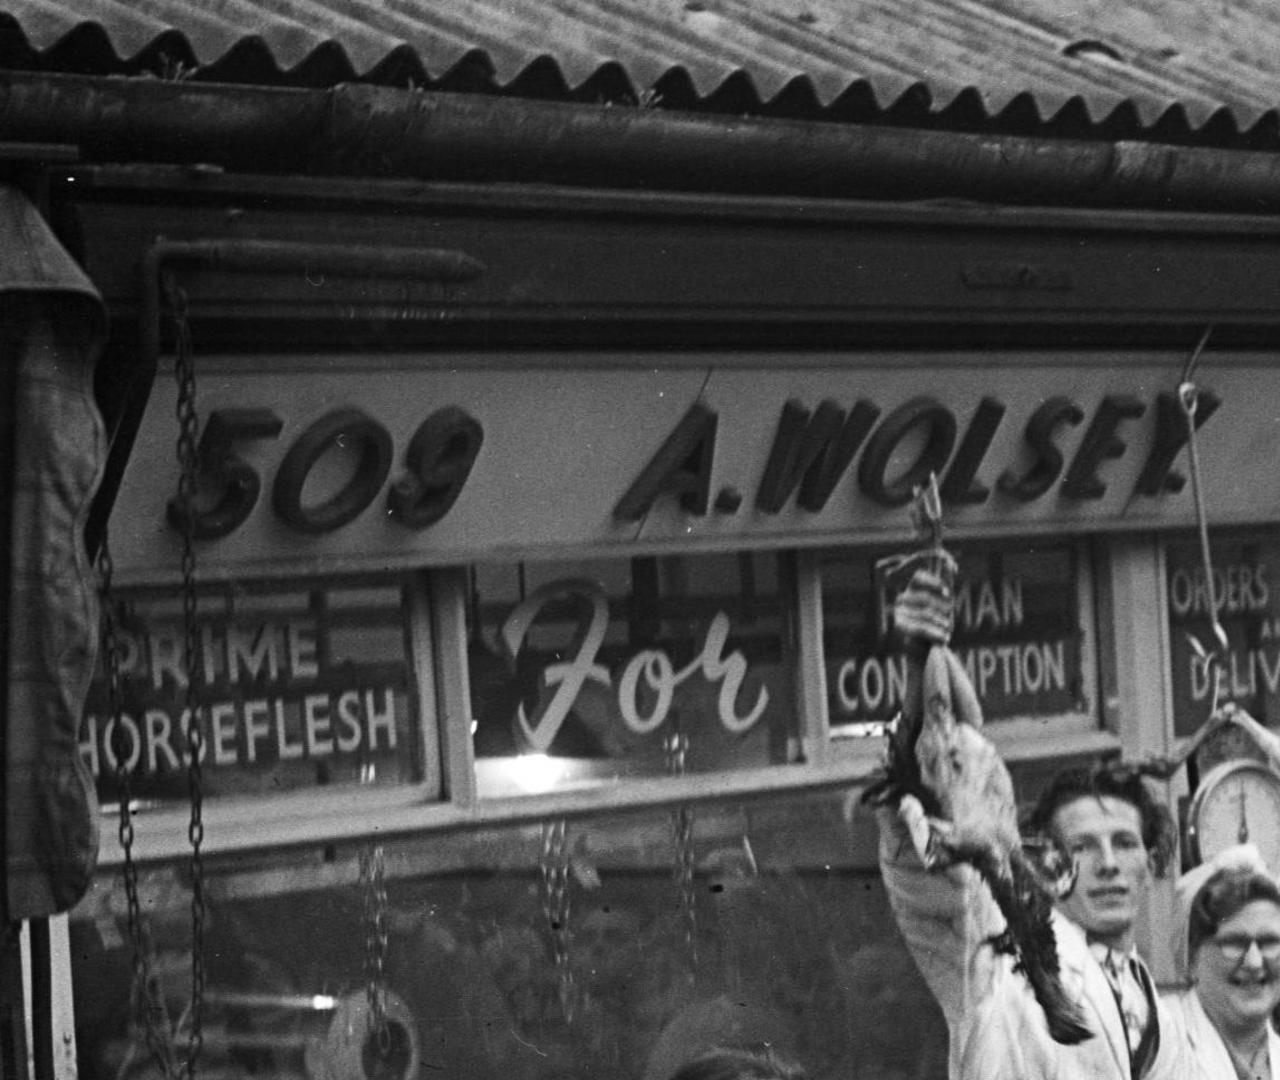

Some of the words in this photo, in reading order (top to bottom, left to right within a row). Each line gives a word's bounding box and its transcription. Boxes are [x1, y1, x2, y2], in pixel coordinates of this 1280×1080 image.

[167, 406, 485, 543] 509
[878, 578, 1024, 633] HMAN
[1170, 563, 1269, 613] ORDERS
[111, 621, 319, 690] PRIME
[502, 577, 769, 752] For
[838, 639, 1066, 710] CONPTION
[78, 687, 397, 777] HORSEFLESH
